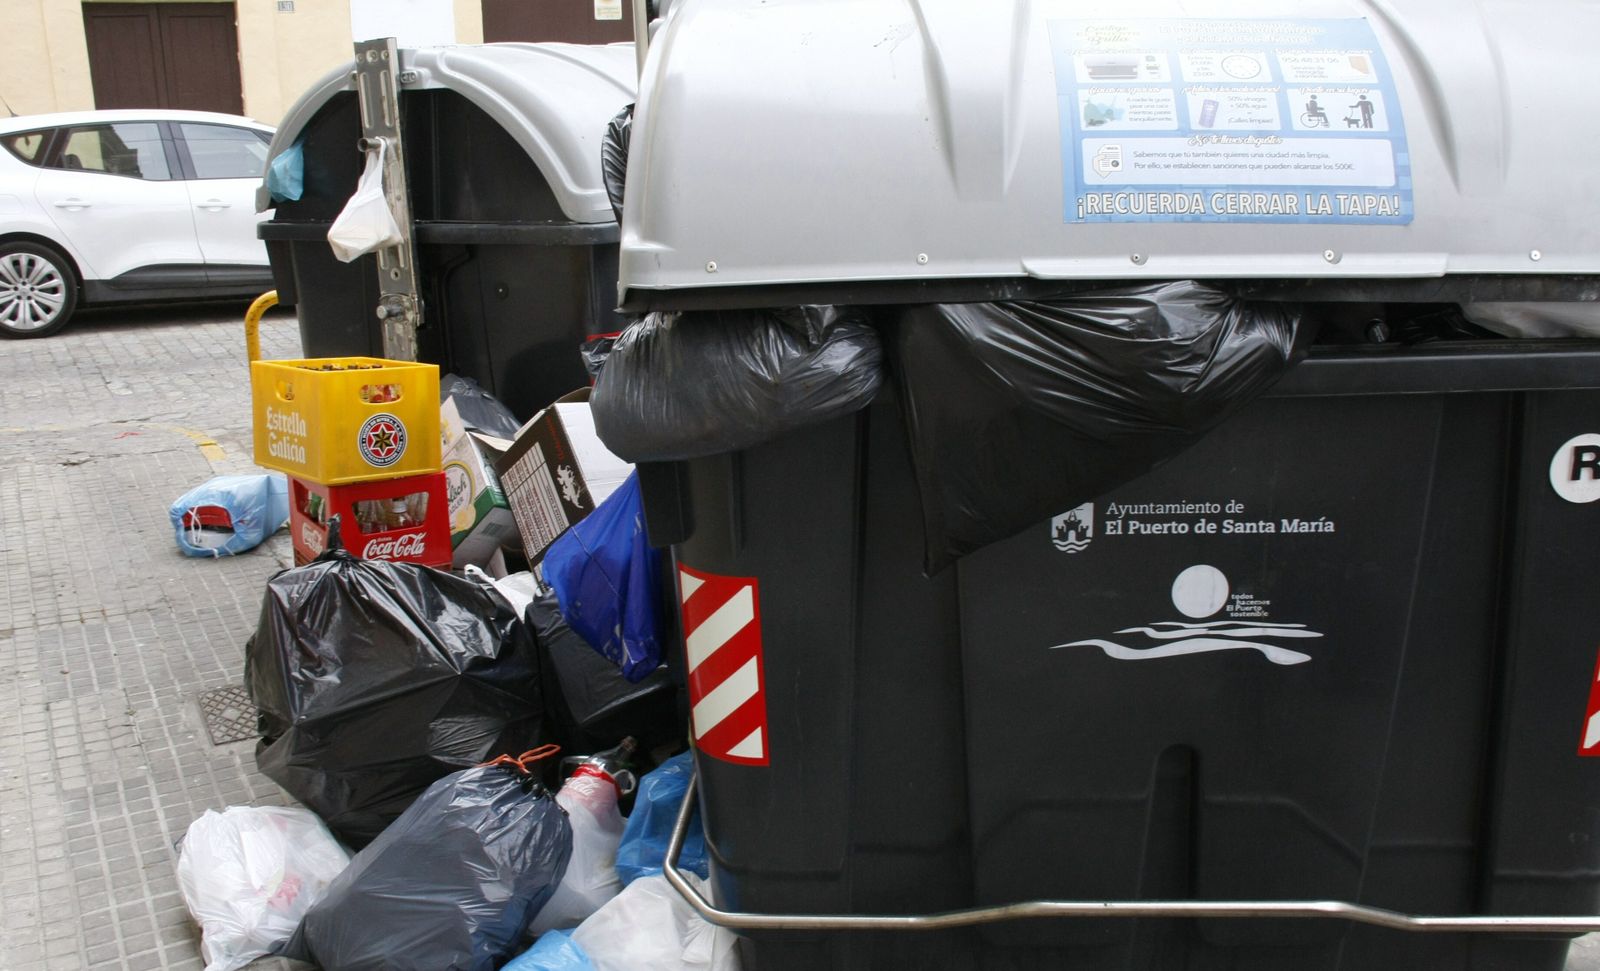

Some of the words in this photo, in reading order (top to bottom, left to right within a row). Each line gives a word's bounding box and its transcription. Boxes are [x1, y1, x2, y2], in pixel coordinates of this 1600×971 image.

[1147, 162, 1162, 170] ello,
[1264, 163, 1292, 171] pueden
[1183, 150, 1191, 158] tú
[1192, 150, 1221, 158] también
[1223, 151, 1249, 159] quieres
[1307, 152, 1330, 160] limpia.
[1077, 192, 1205, 219] ¡RECUERDA
[1210, 192, 1299, 215] CERRAR
[1305, 193, 1332, 215] LA
[1336, 194, 1400, 216] TAPA!
[267, 406, 307, 437] Estrella
[269, 432, 306, 464] Galicia
[1570, 445, 1600, 481] R
[1106, 500, 1220, 518] Ayuntamiento
[1225, 500, 1245, 514] de
[1105, 521, 1122, 535] El
[1128, 520, 1190, 535] Puerto
[1194, 519, 1217, 534] de
[1222, 519, 1275, 534] Santa
[1280, 516, 1335, 533] María
[363, 532, 427, 560] Coca-Cola
